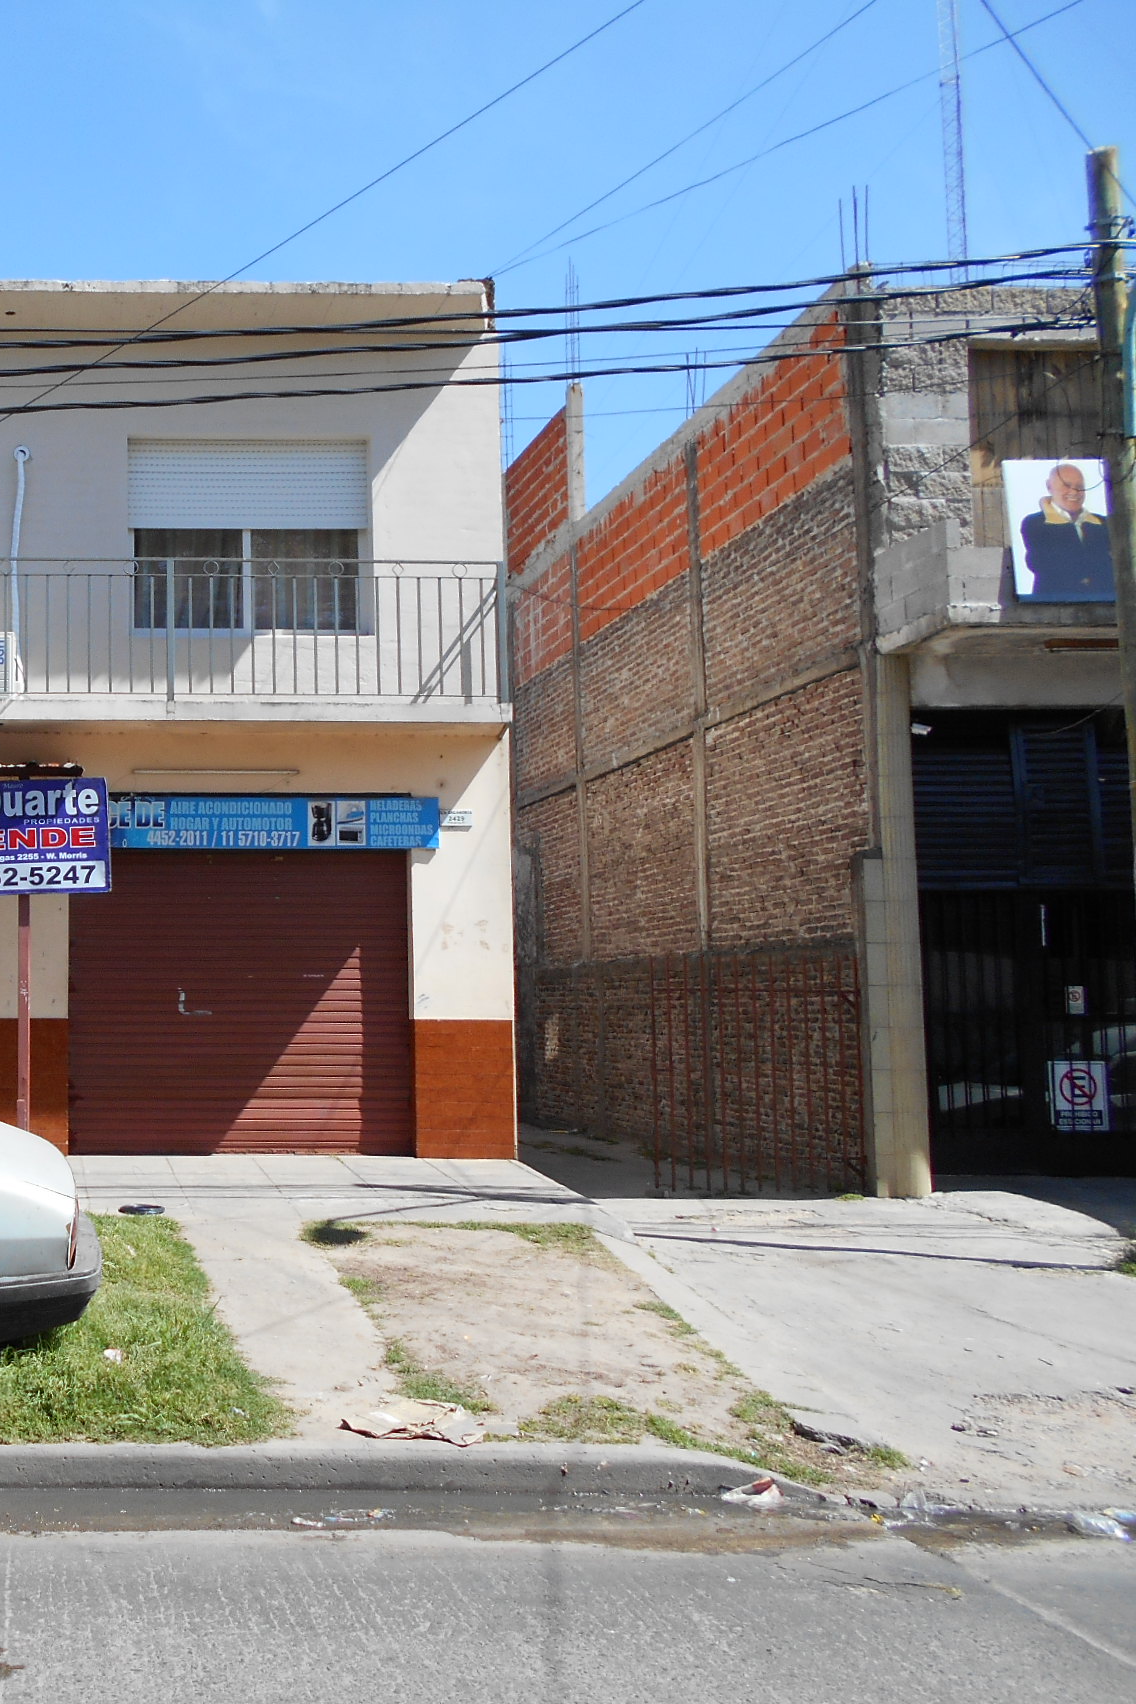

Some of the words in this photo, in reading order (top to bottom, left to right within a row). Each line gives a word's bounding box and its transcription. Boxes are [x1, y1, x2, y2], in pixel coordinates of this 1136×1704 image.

[170, 801, 197, 815] AIRE
[197, 801, 293, 815] ACONDICIONADO
[369, 799, 423, 811] HELADERAS
[23, 816, 100, 826] PROPIEDADES
[134, 801, 166, 829] DE
[370, 811, 419, 823] PLANCHAS
[170, 817, 210, 831] HOGAR
[211, 817, 220, 831] Y
[221, 817, 293, 831] AUTOMOTOR
[370, 823, 434, 835] MICROONDAS
[147, 830, 208, 846] 4452-2011
[211, 831, 218, 848] /
[220, 831, 235, 846] 11
[370, 835, 423, 847] CAFETERAS
[16, 853, 40, 861] 2255
[46, 852, 57, 860] W.
[58, 851, 88, 860] Morris
